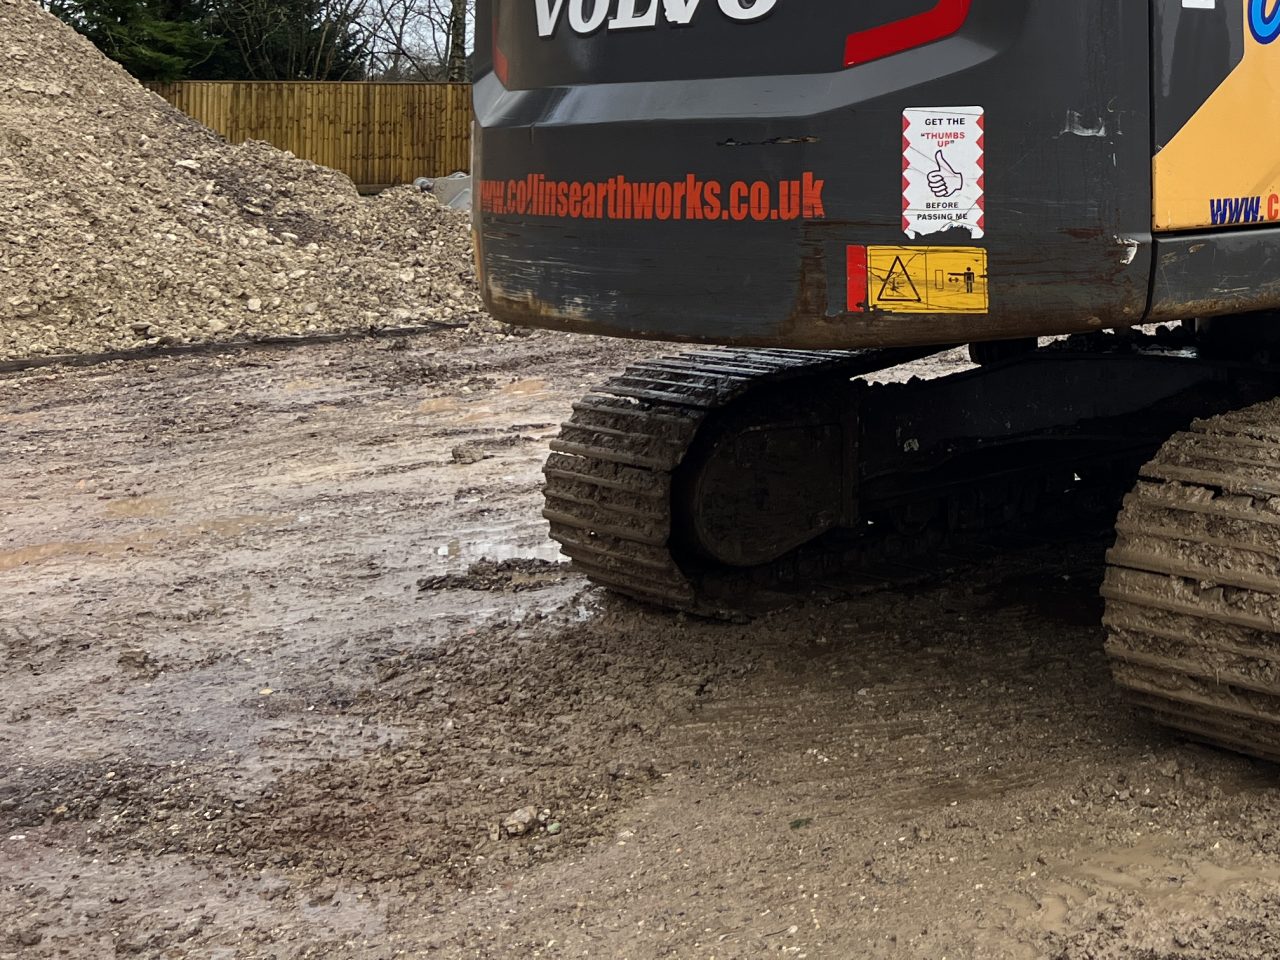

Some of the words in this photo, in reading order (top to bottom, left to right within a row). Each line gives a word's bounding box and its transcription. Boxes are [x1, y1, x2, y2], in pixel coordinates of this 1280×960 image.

[924, 118, 944, 126] GET
[946, 117, 966, 126] THE
[925, 201, 959, 209] BEFORE
[916, 213, 953, 221] PASSING
[955, 212, 968, 220] ME
